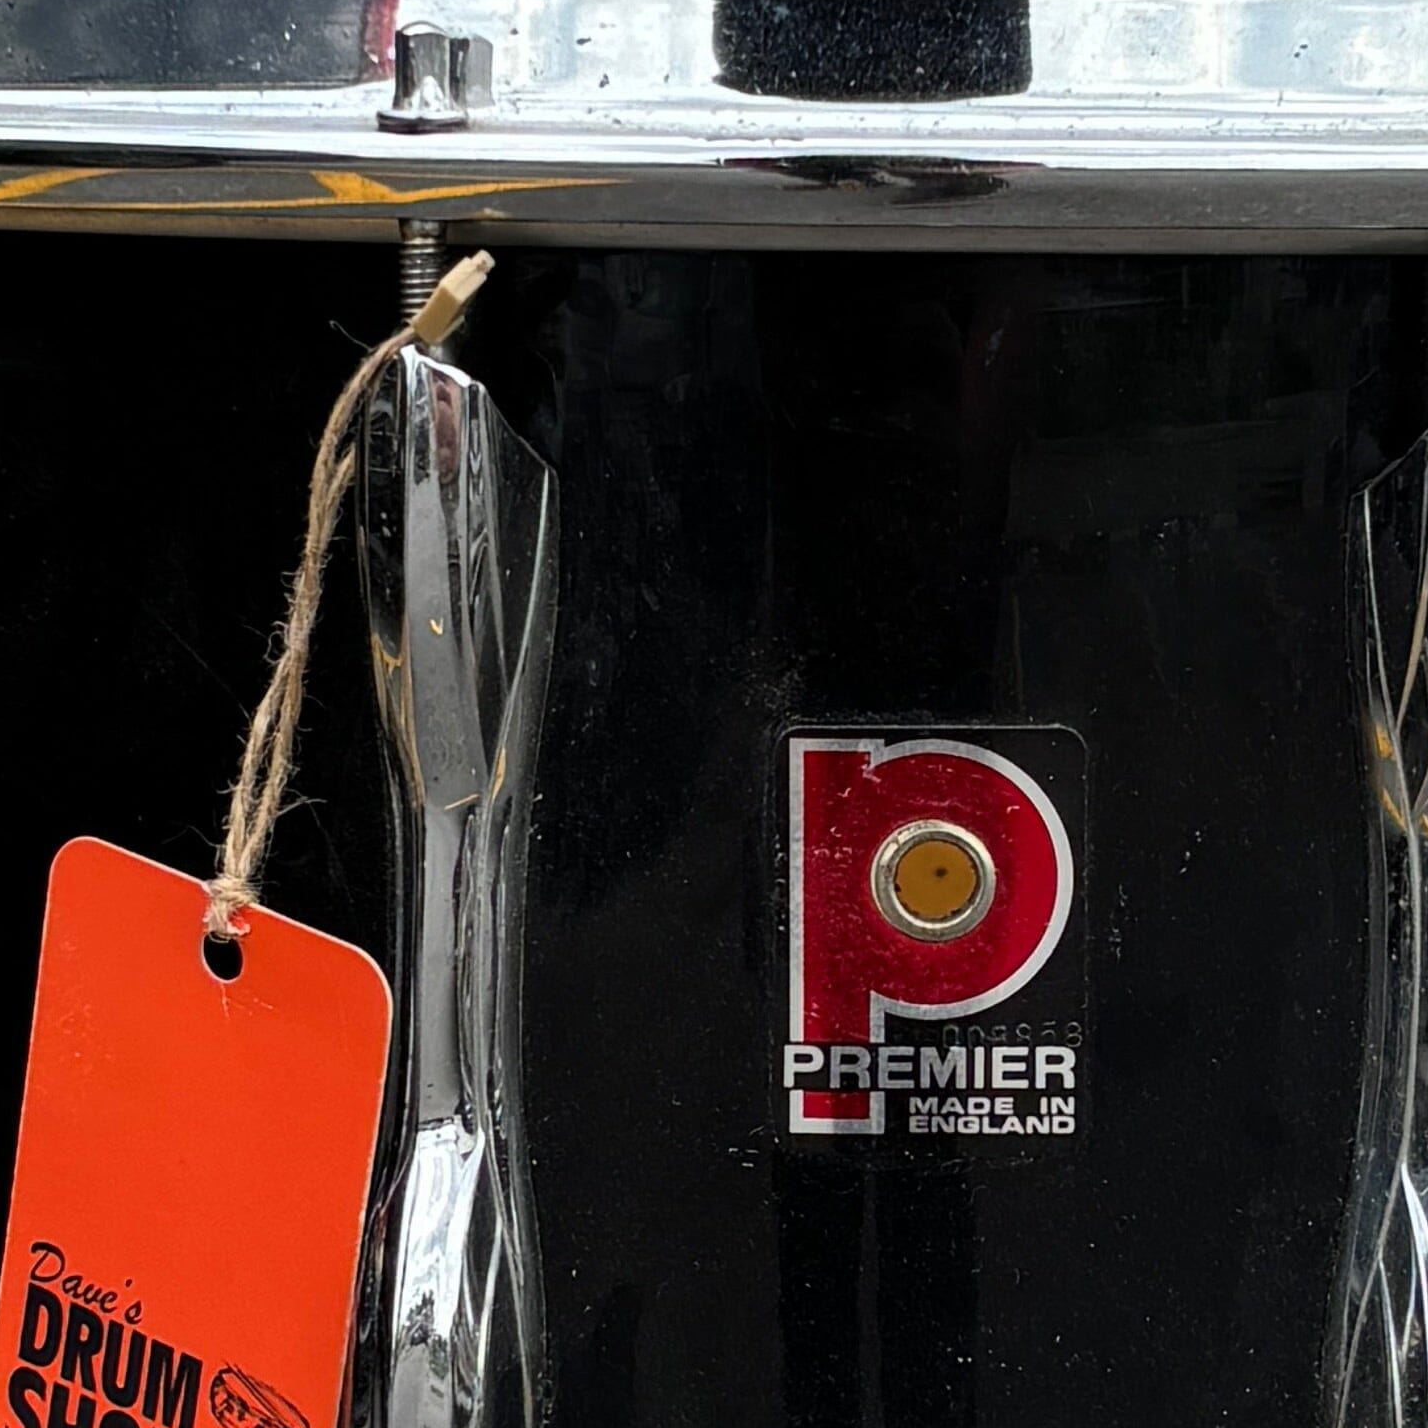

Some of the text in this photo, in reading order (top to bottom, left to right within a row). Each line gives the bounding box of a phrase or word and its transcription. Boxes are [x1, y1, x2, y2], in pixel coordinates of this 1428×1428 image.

[783, 1044, 1076, 1090] PREMIER
[909, 1096, 1076, 1115] MADE IN
[909, 1115, 1076, 1134] ENGLAND
[29, 1241, 143, 1325] Dave's
